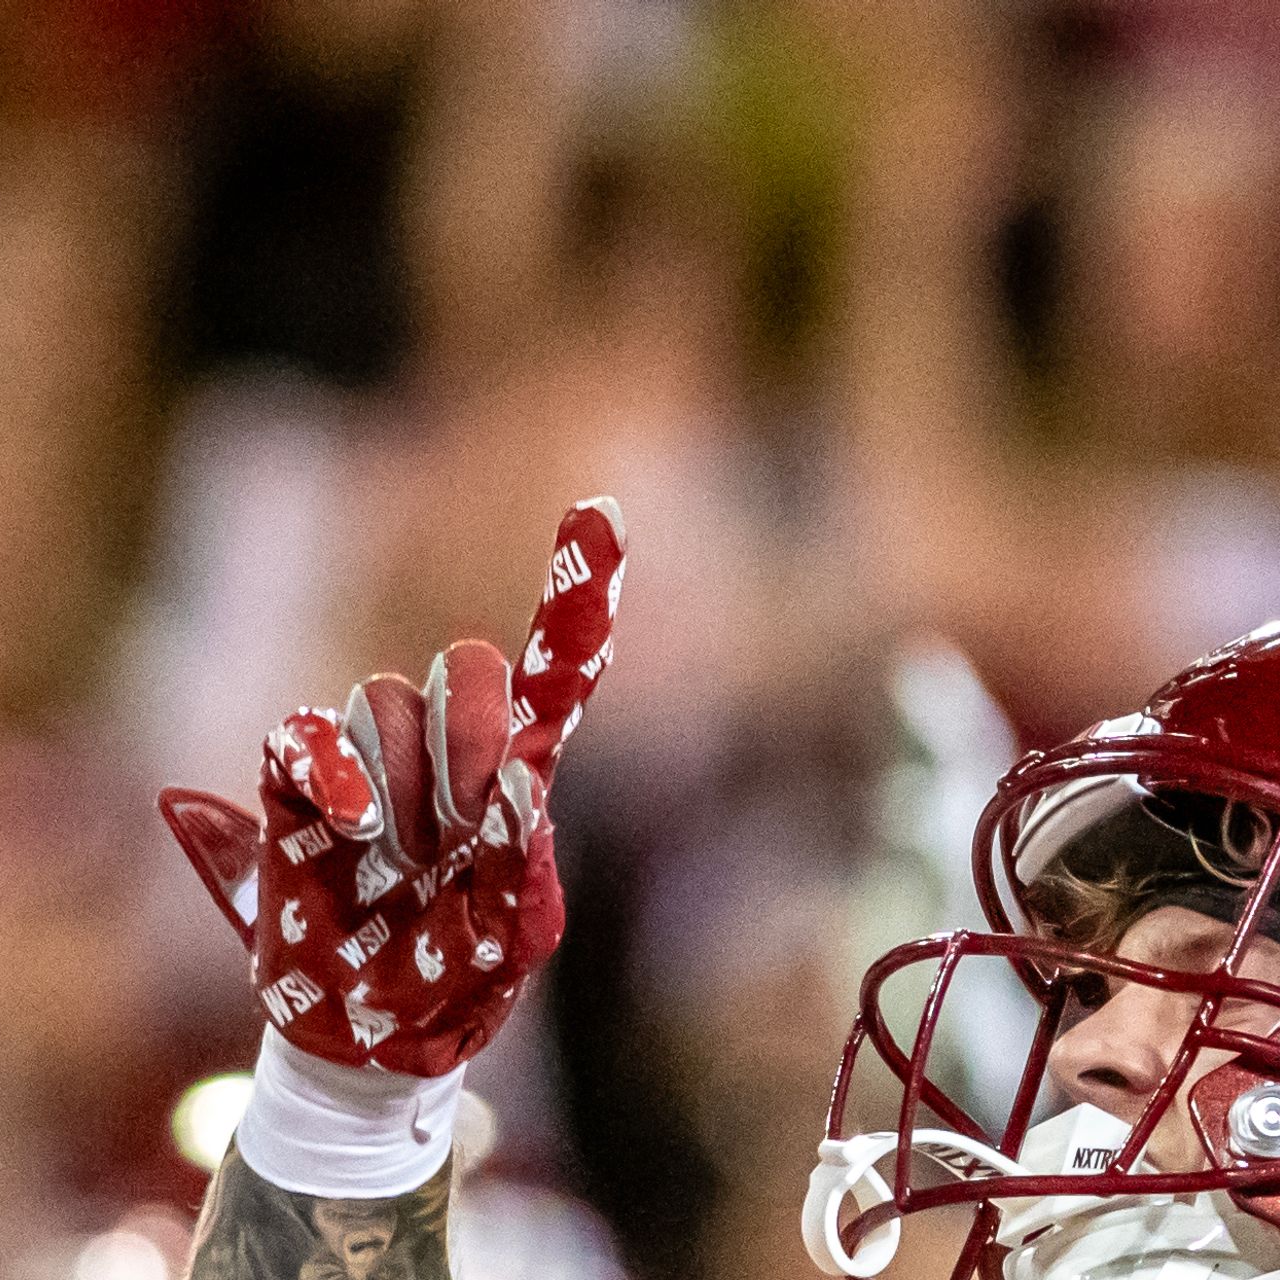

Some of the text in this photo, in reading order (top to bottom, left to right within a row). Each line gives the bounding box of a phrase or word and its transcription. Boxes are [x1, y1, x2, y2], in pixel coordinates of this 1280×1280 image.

[278, 821, 334, 865] WSU
[336, 913, 391, 970] WSU
[261, 968, 327, 1028] WSU
